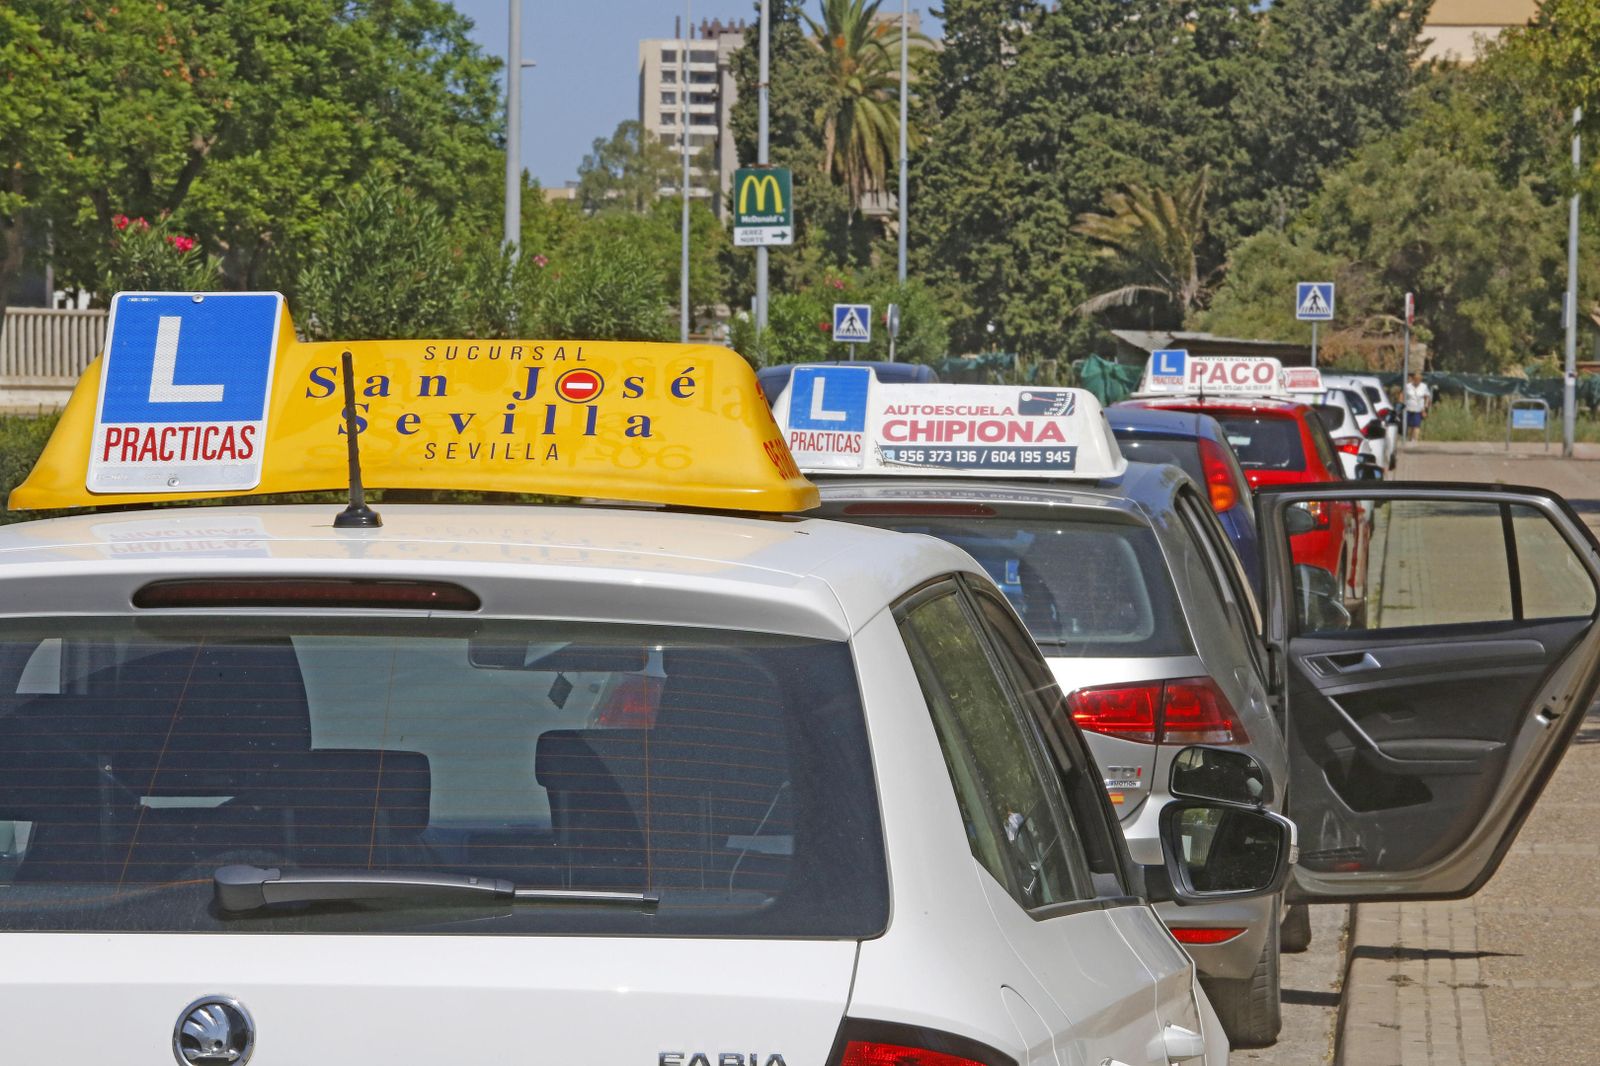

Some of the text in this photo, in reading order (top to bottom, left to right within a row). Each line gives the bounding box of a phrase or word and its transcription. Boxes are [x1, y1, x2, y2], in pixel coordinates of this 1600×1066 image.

[741, 215, 785, 223] McDonald's
[149, 316, 225, 403] L
[424, 345, 586, 361] SUCURSAL
[1161, 354, 1177, 372] L
[306, 366, 448, 398] San
[1152, 376, 1184, 384] PRACTICAS
[1190, 361, 1274, 384] PACO
[810, 376, 847, 422] L
[883, 404, 1014, 416] AUTOESCUELA
[338, 402, 652, 438] Sevilla
[882, 419, 1066, 443] CHIPIONA
[103, 425, 256, 462] PRACTICAS
[424, 442, 559, 460] SEVILLA
[789, 431, 862, 453] PRACTICAS
[899, 450, 925, 462] 956
[929, 450, 952, 462] 373
[956, 450, 977, 463] 136
[991, 450, 1016, 463] 604
[1020, 450, 1041, 463] 195
[1045, 450, 1071, 463] 945
